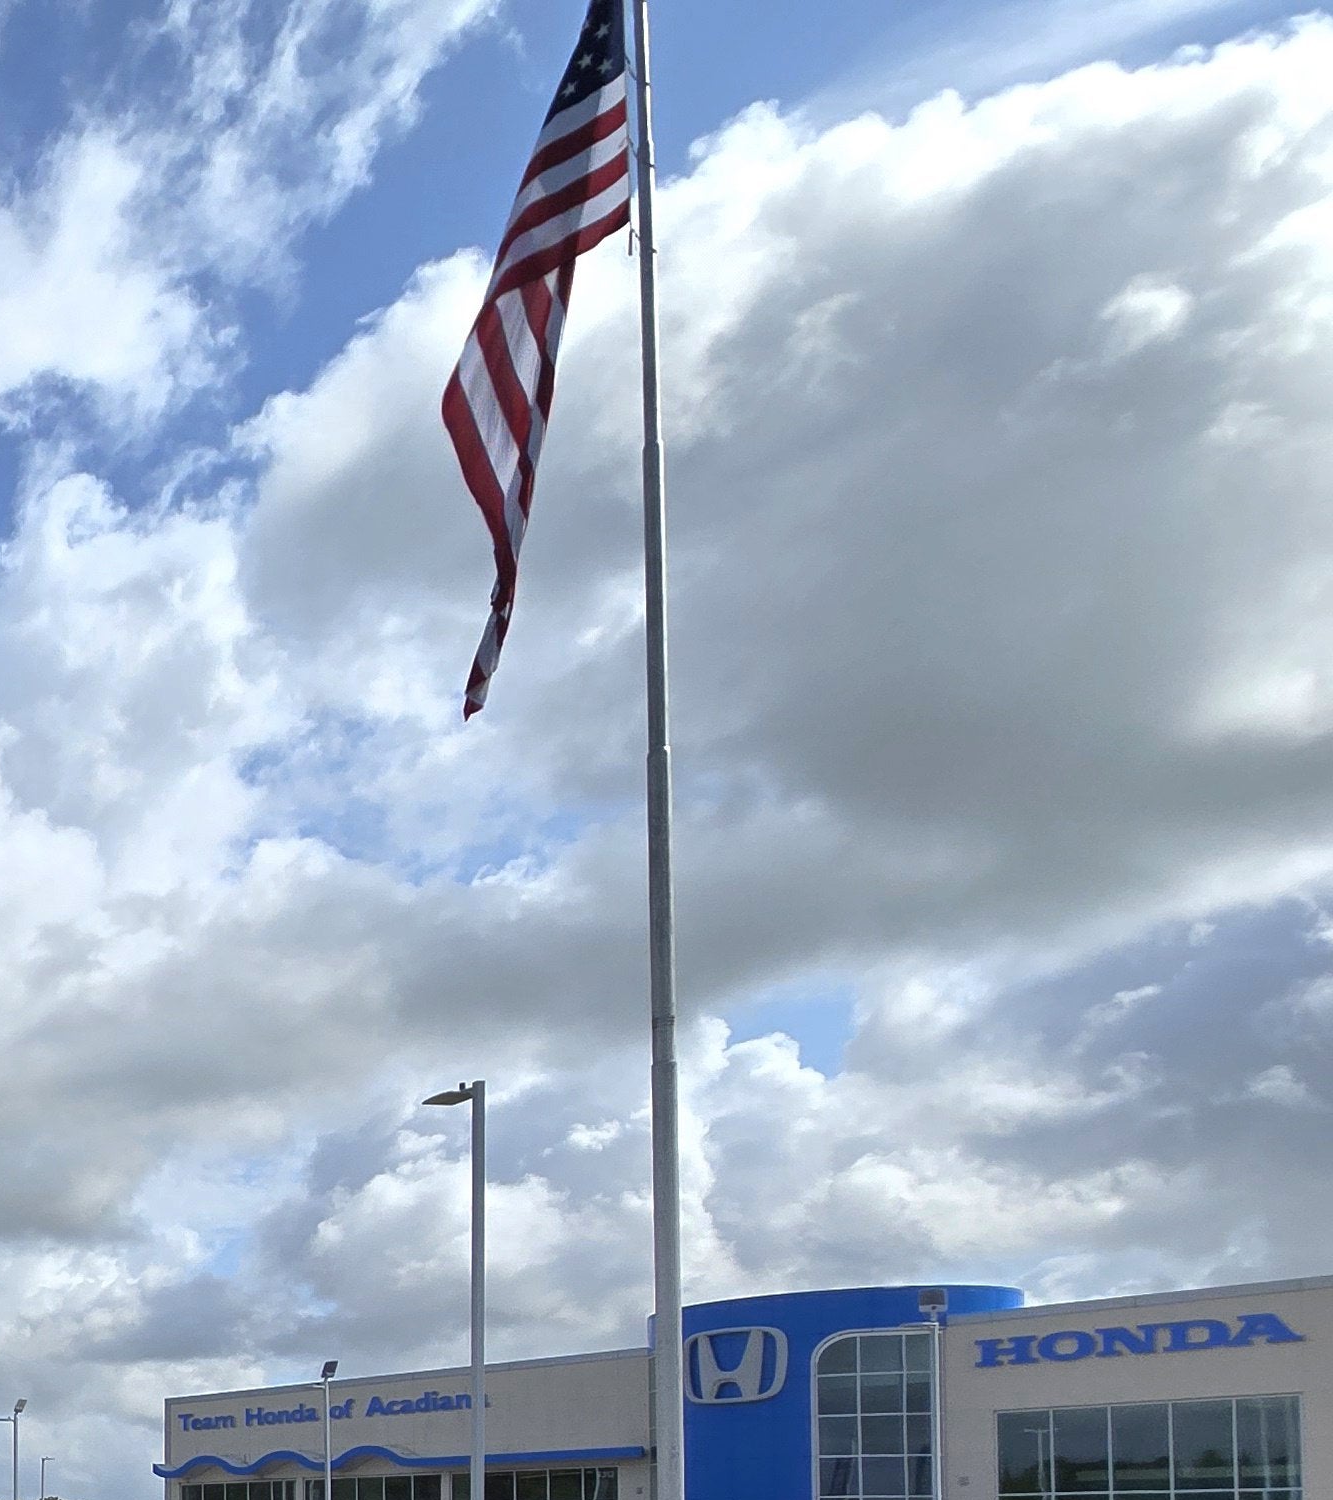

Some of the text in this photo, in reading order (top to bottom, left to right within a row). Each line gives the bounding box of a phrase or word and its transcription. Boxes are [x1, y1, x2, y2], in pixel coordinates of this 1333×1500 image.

[974, 1312, 1307, 1369] HONDA
[178, 1412, 236, 1432] Team
[244, 1402, 319, 1427] Honda
[329, 1398, 355, 1419] of
